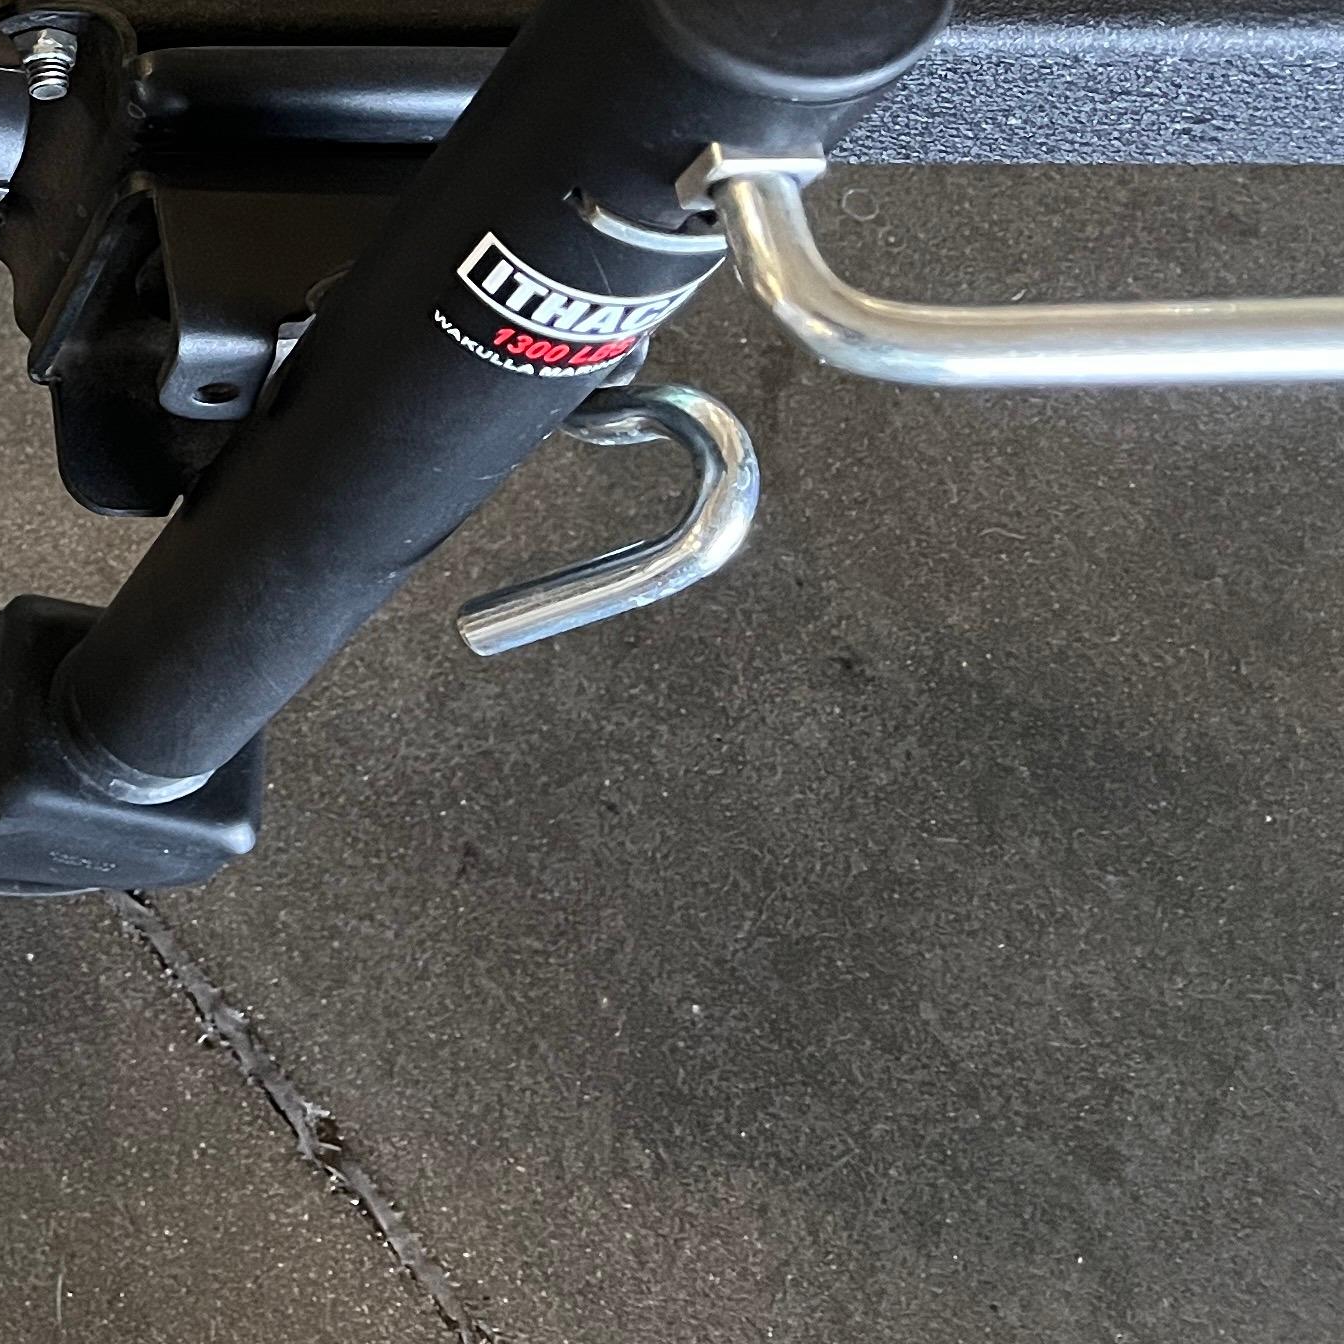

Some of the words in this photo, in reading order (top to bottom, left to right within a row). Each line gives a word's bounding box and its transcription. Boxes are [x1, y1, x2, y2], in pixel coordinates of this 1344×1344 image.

[481, 259, 686, 334] ITHAC
[434, 309, 535, 375] WAKULLA
[494, 328, 570, 362] 1300
